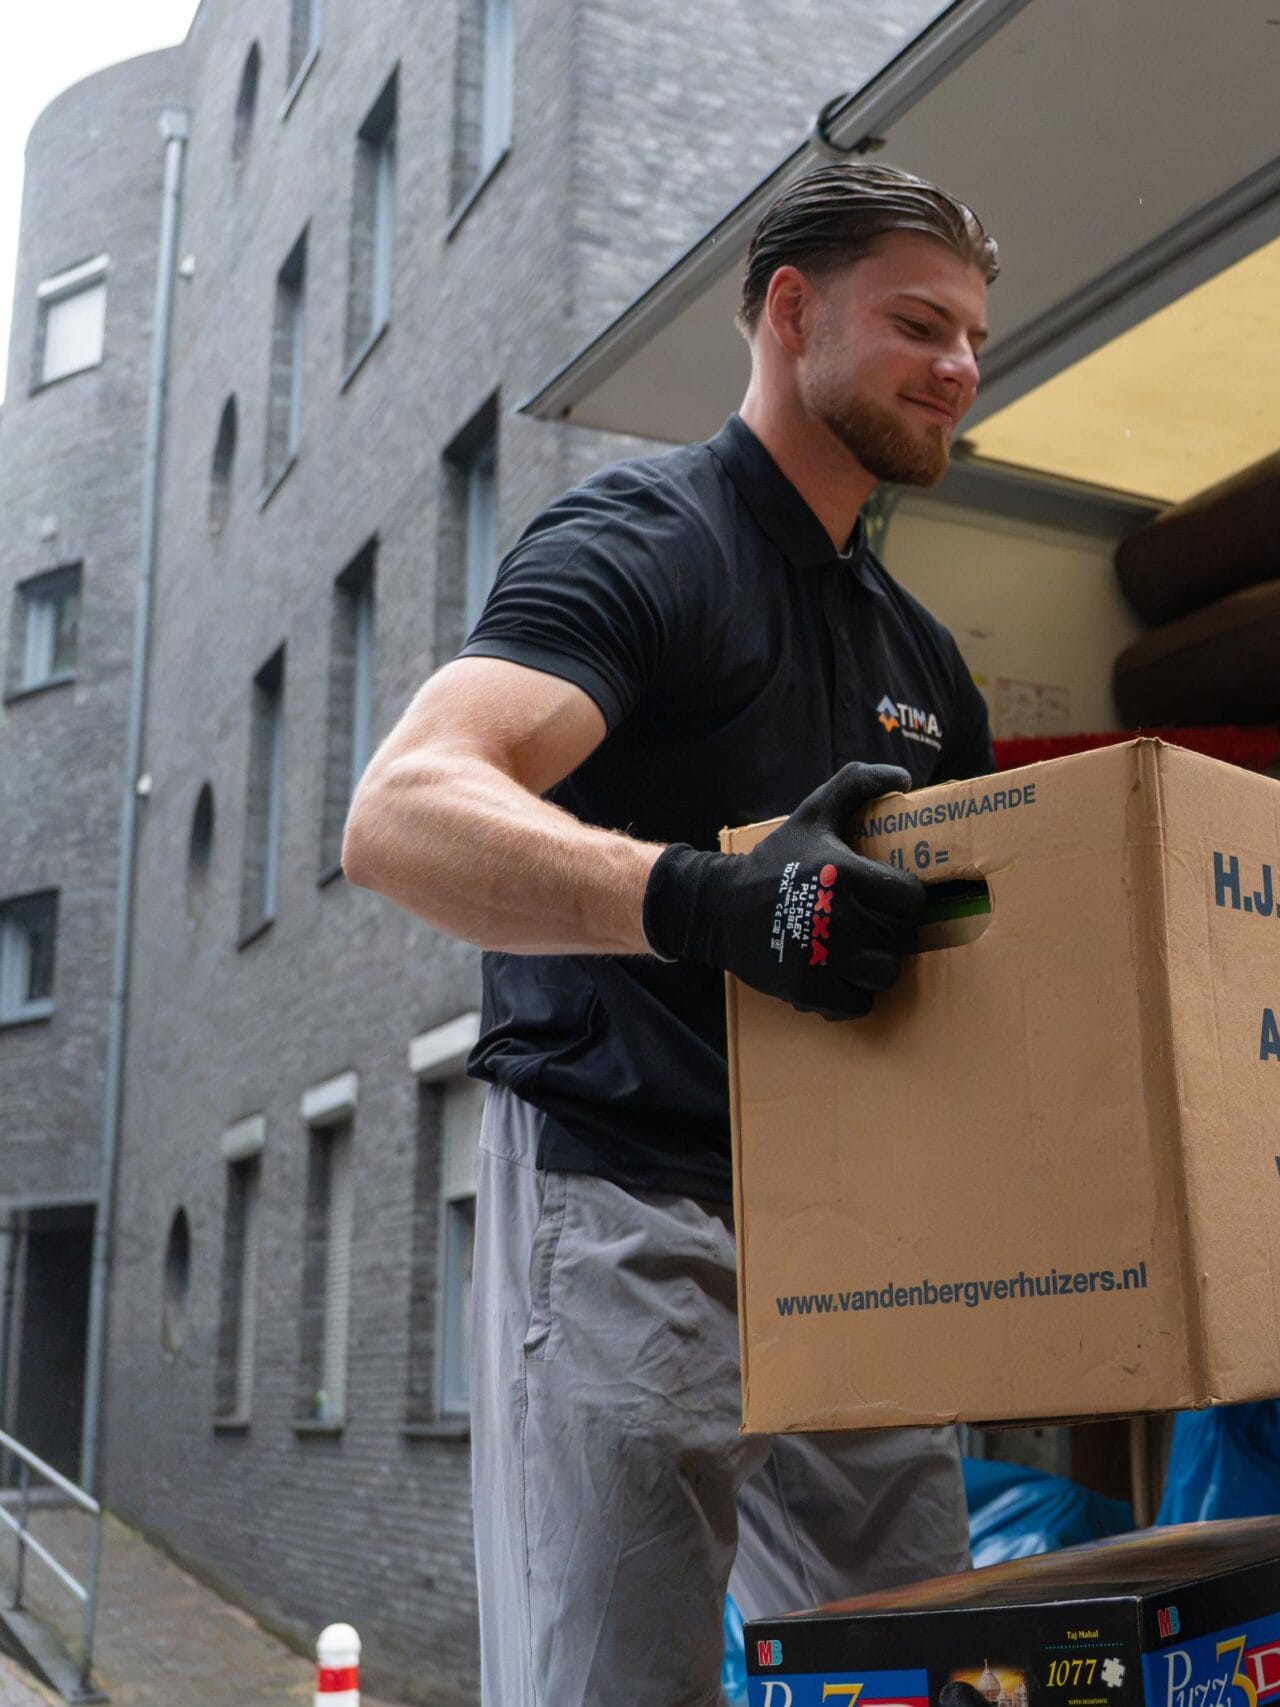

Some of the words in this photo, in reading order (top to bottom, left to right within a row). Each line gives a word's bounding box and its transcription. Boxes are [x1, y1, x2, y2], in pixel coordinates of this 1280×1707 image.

[896, 702, 942, 738] TIMA
[853, 784, 1036, 841] ANGINGSWAARDE
[779, 862, 795, 893] 10/XL
[791, 883, 809, 940] PU-FLEX
[801, 876, 818, 949] ESSENTIAL
[809, 864, 837, 965] OXXA
[776, 1262, 1148, 1316] www.vandenbergverhuizers.nl
[1157, 1605, 1181, 1639] MB
[757, 1639, 783, 1666] MB
[1046, 1658, 1097, 1687] 1077
